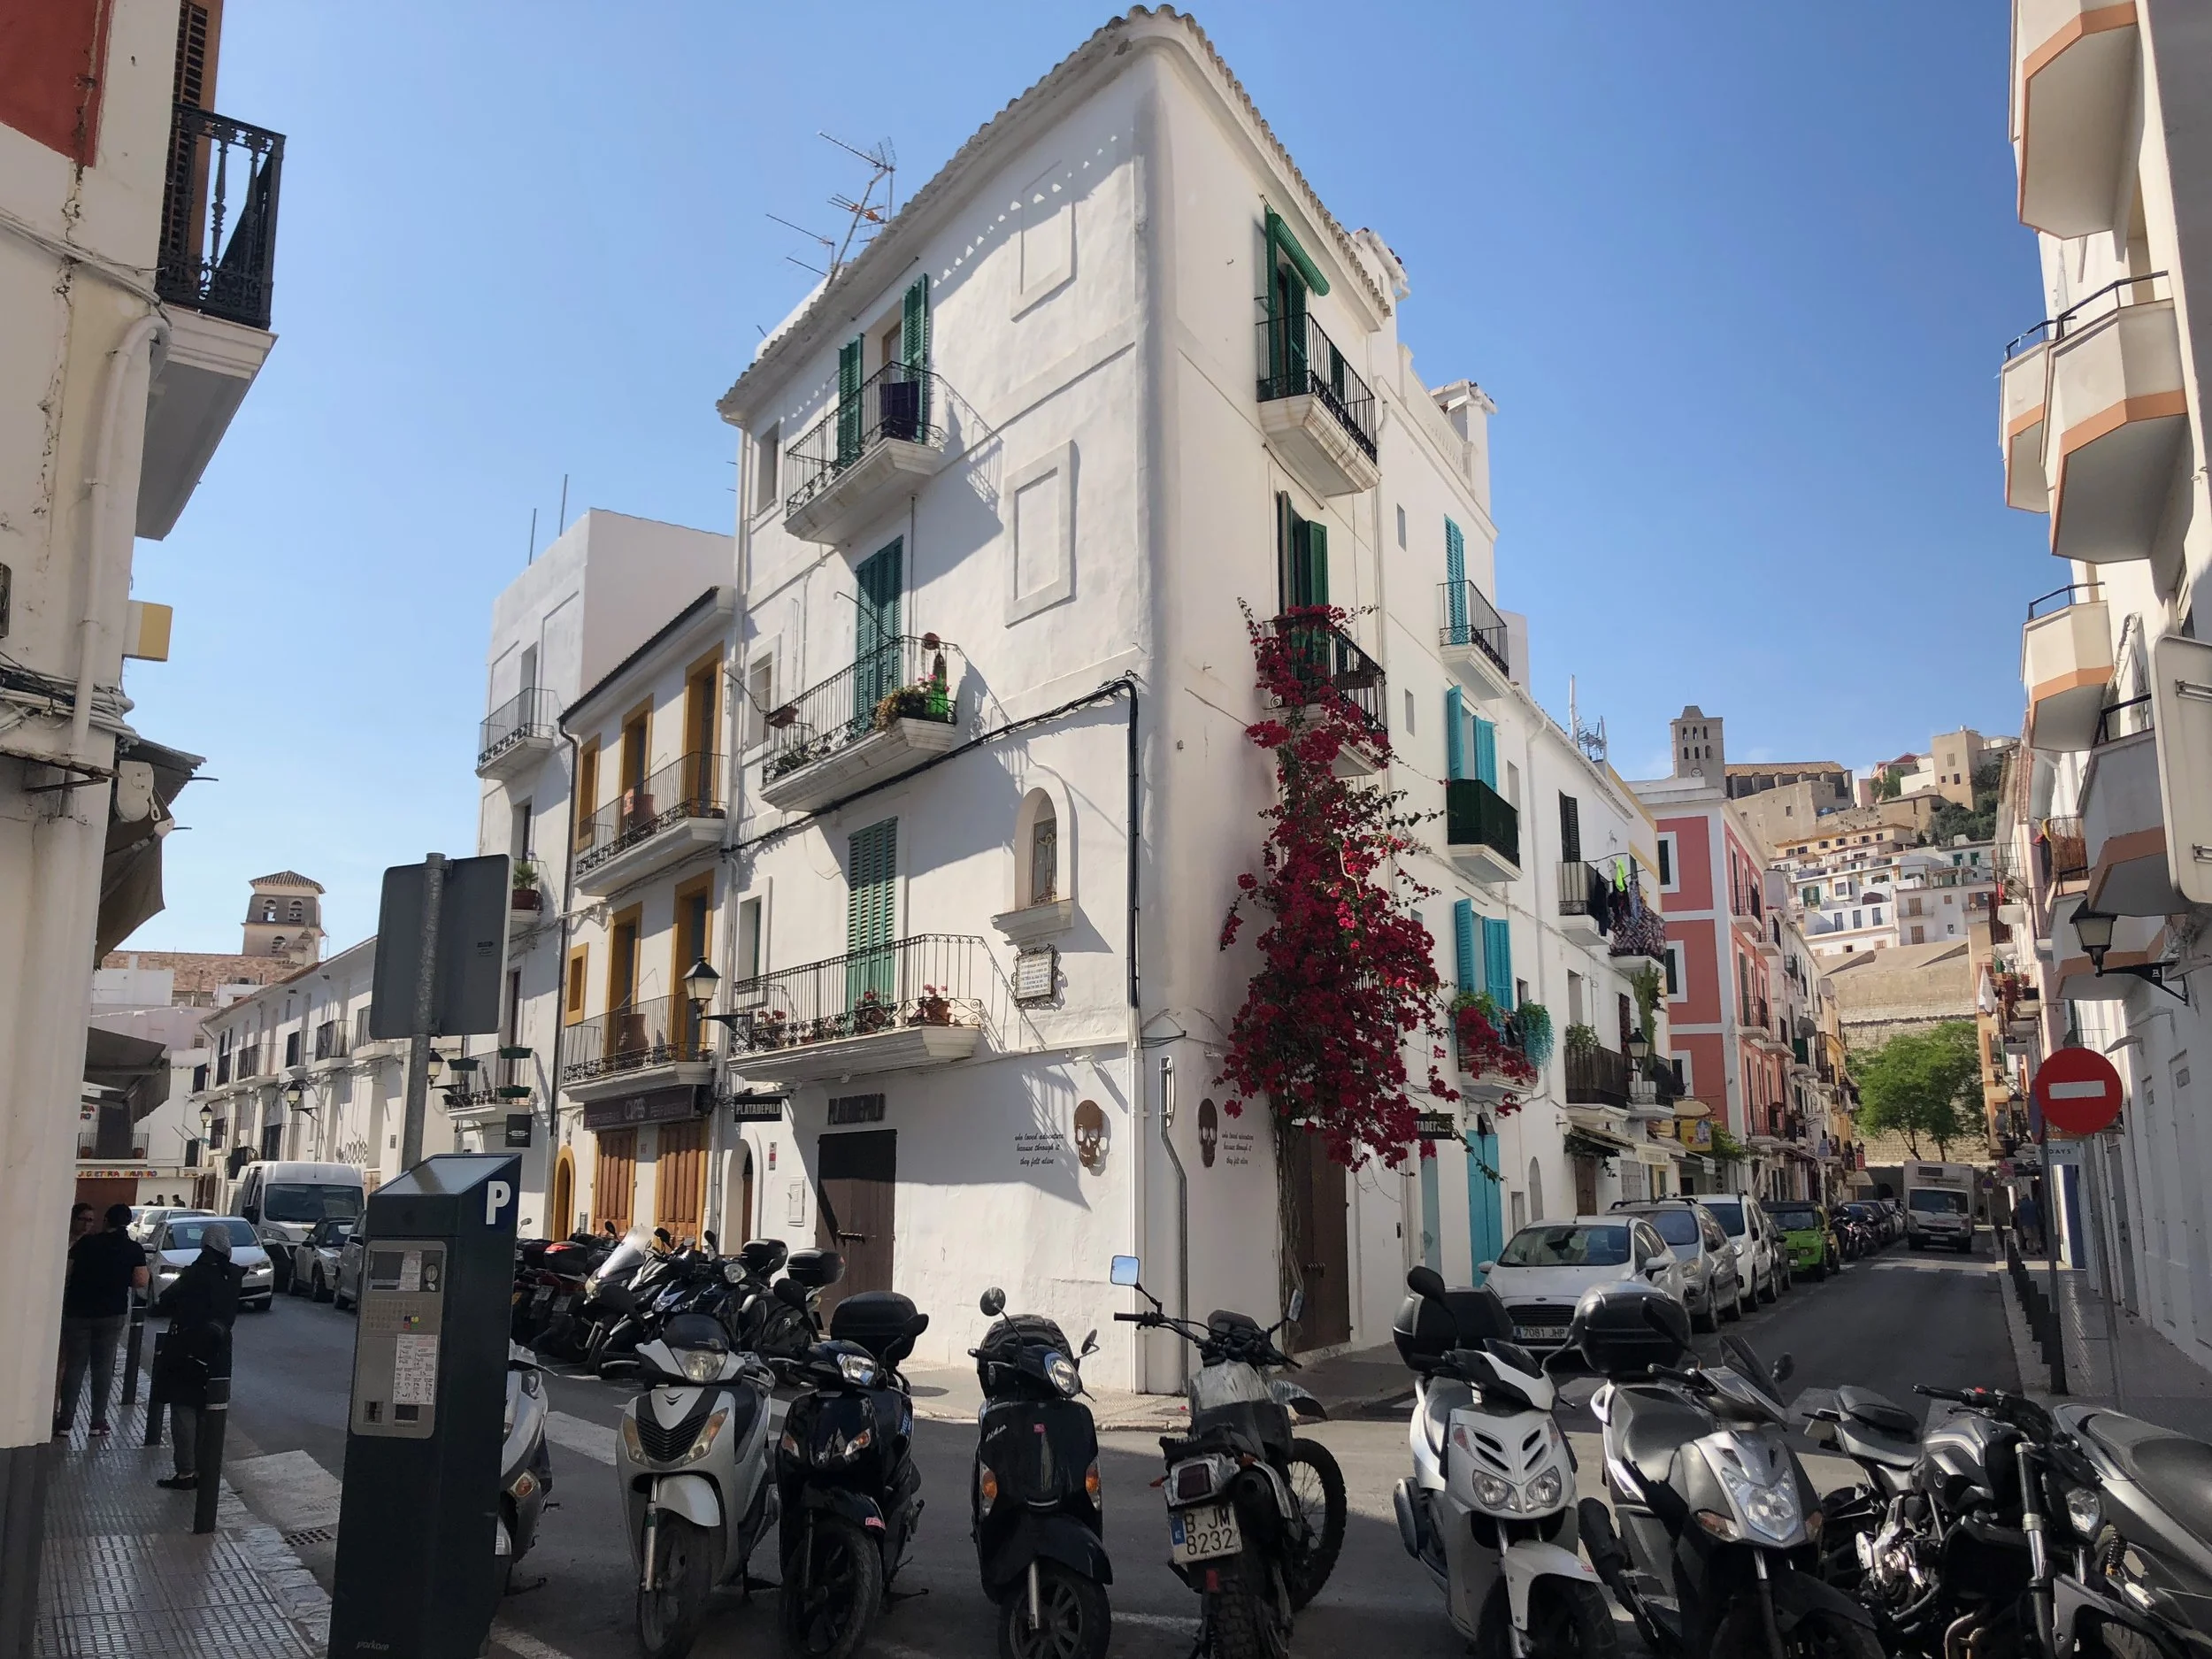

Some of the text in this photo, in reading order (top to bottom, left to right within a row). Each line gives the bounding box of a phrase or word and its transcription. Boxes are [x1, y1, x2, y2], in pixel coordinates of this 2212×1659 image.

[735, 1103, 781, 1115] PLATADEPALO
[486, 1180, 511, 1225] P
[1524, 1328, 1545, 1339] 7081
[1186, 1507, 1231, 1534] B JM
[1186, 1528, 1234, 1555] 8232
